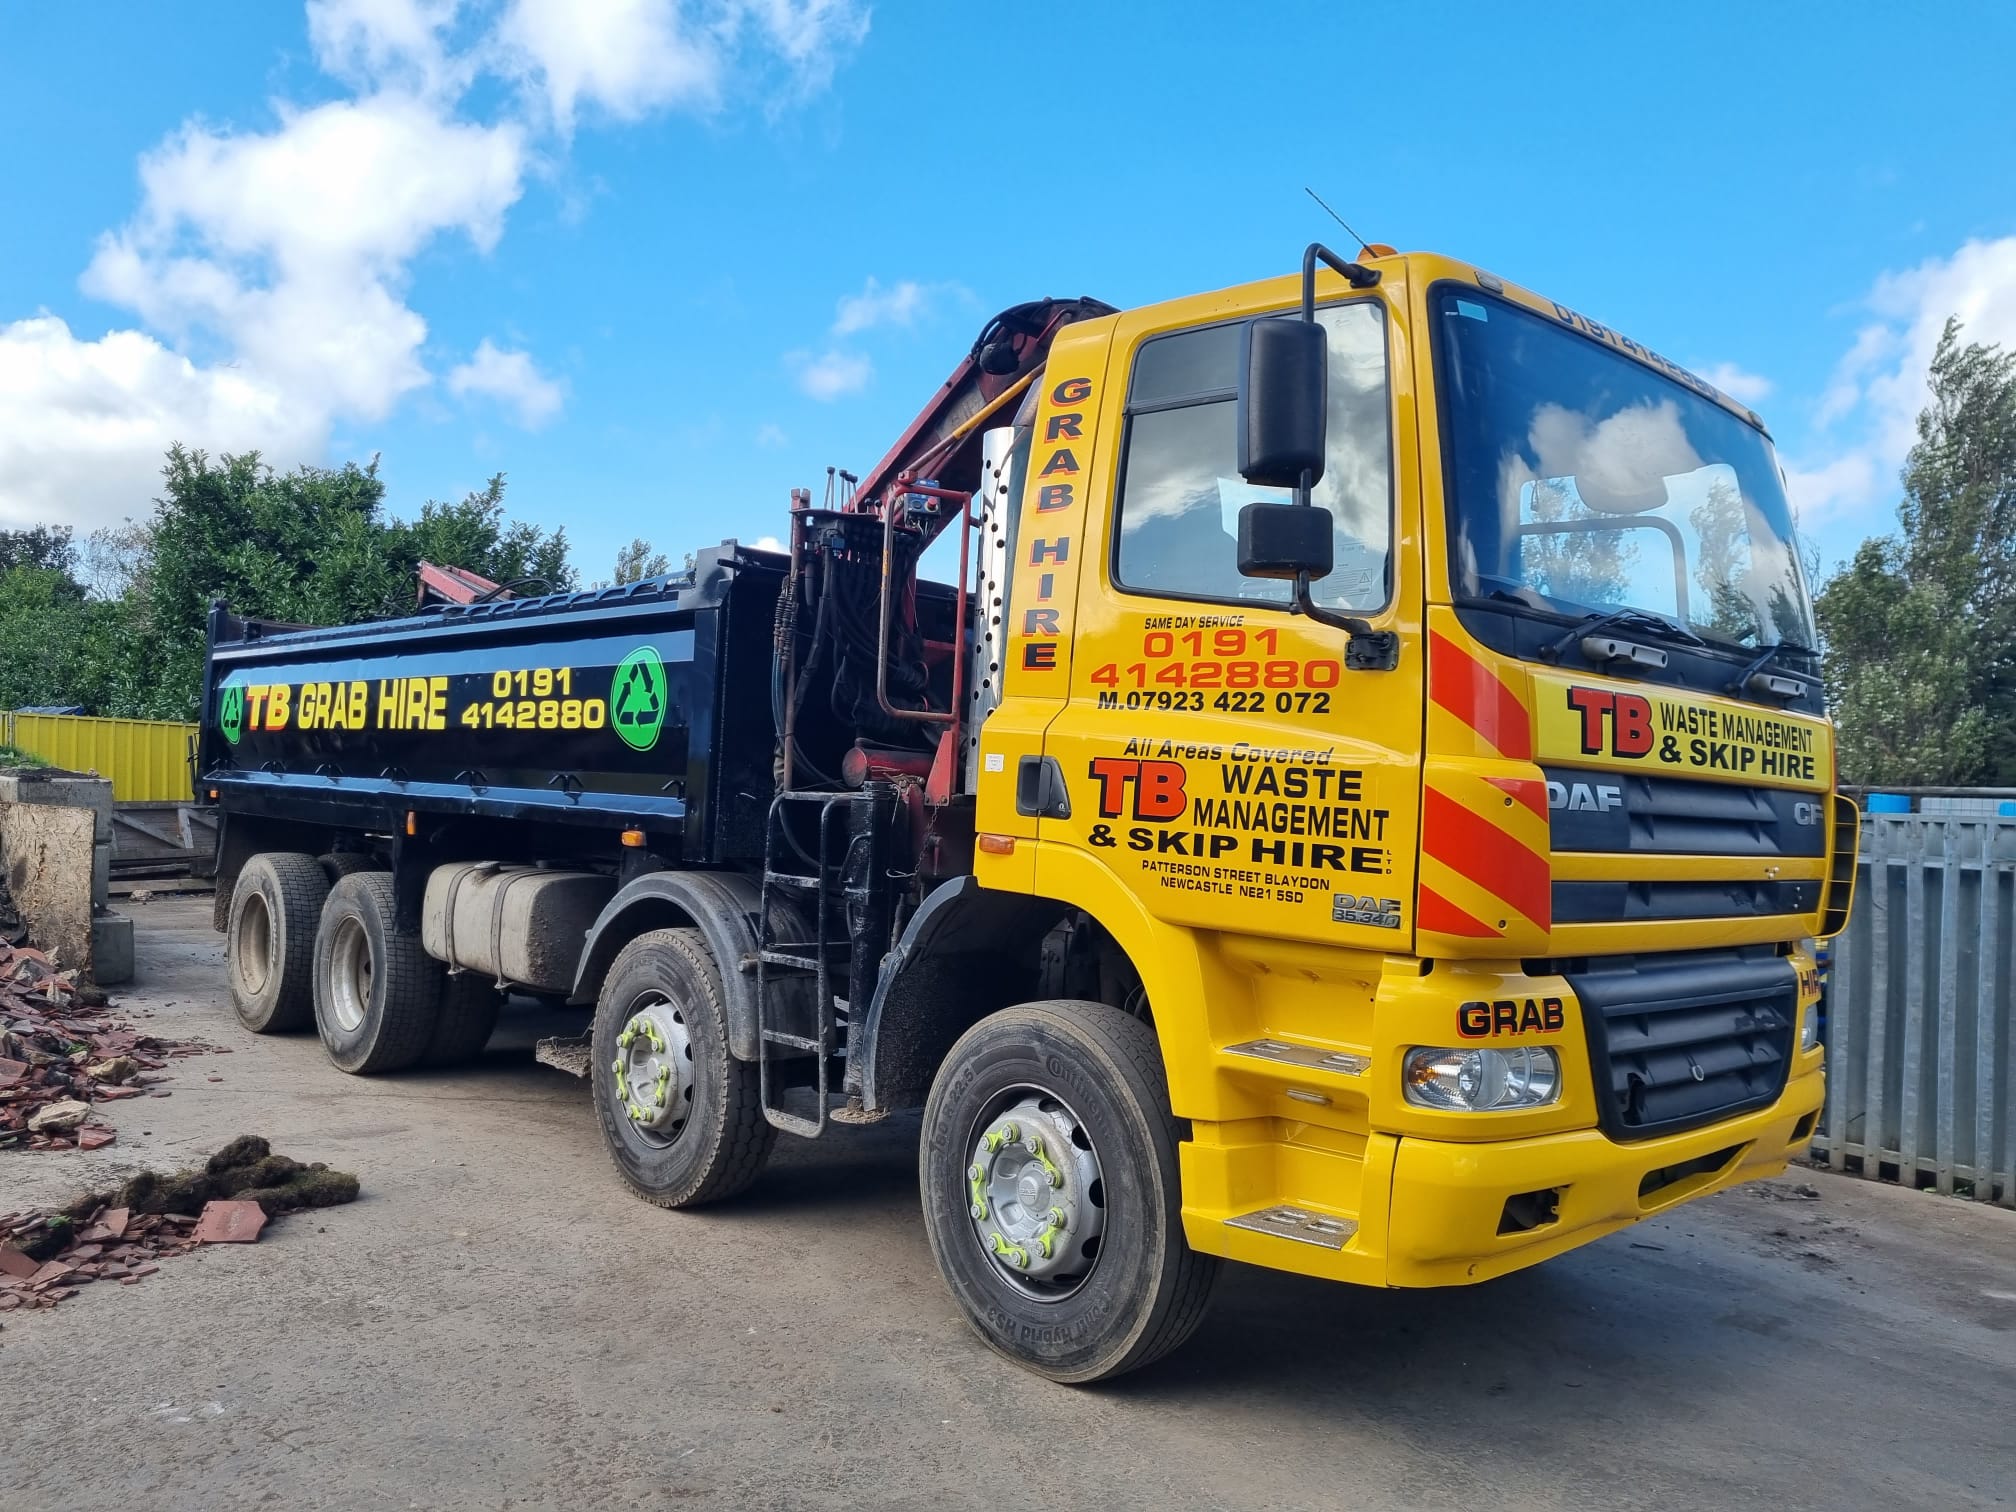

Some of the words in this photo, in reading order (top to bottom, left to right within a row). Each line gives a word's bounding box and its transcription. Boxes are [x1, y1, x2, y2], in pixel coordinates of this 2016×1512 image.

[1552, 302, 1616, 345] 0191
[1036, 377, 1093, 514] GRAB
[1022, 536, 1070, 672] HIRE
[1144, 616, 1174, 630] SAME
[1175, 616, 1196, 629] DAY
[1199, 615, 1244, 628] SERVICE
[1143, 628, 1278, 658] 0191
[493, 667, 571, 698] 0191
[1090, 660, 1340, 689] 4142880
[245, 682, 291, 732] TB
[297, 680, 368, 729] GRAB
[376, 677, 449, 730] HIRE
[461, 699, 605, 730] 4142880
[1097, 691, 1204, 712] M.07923
[1213, 692, 1265, 713] 422
[1275, 692, 1331, 714] 072
[1567, 685, 1654, 759] TB
[1659, 702, 1717, 738] WASTE
[1722, 713, 1813, 753] MANAGEMENT
[1123, 738, 1151, 758] All
[1157, 740, 1222, 761] Areas
[1230, 742, 1335, 766] Covered
[1659, 735, 1682, 764] &
[1690, 739, 1756, 772] SKIP
[1761, 750, 1815, 780] HIRE
[1088, 757, 1187, 823] TB
[1221, 764, 1362, 802] WASTE
[1546, 781, 1622, 812] DAF
[1193, 798, 1390, 842] MANAGEMENT
[1794, 802, 1824, 825] CF
[1088, 824, 1117, 848] &
[1127, 827, 1238, 859] SKIP
[1251, 838, 1383, 875] HIRE
[1142, 860, 1211, 879] PATTERSON
[1213, 867, 1261, 884] STREET
[1265, 873, 1330, 891] BLAYDON
[1160, 876, 1233, 896] NEWCASTLE
[1239, 885, 1272, 900] NE21
[1276, 889, 1304, 904] 5SD
[1333, 893, 1401, 914] DAF
[1455, 997, 1564, 1039] GRAB
